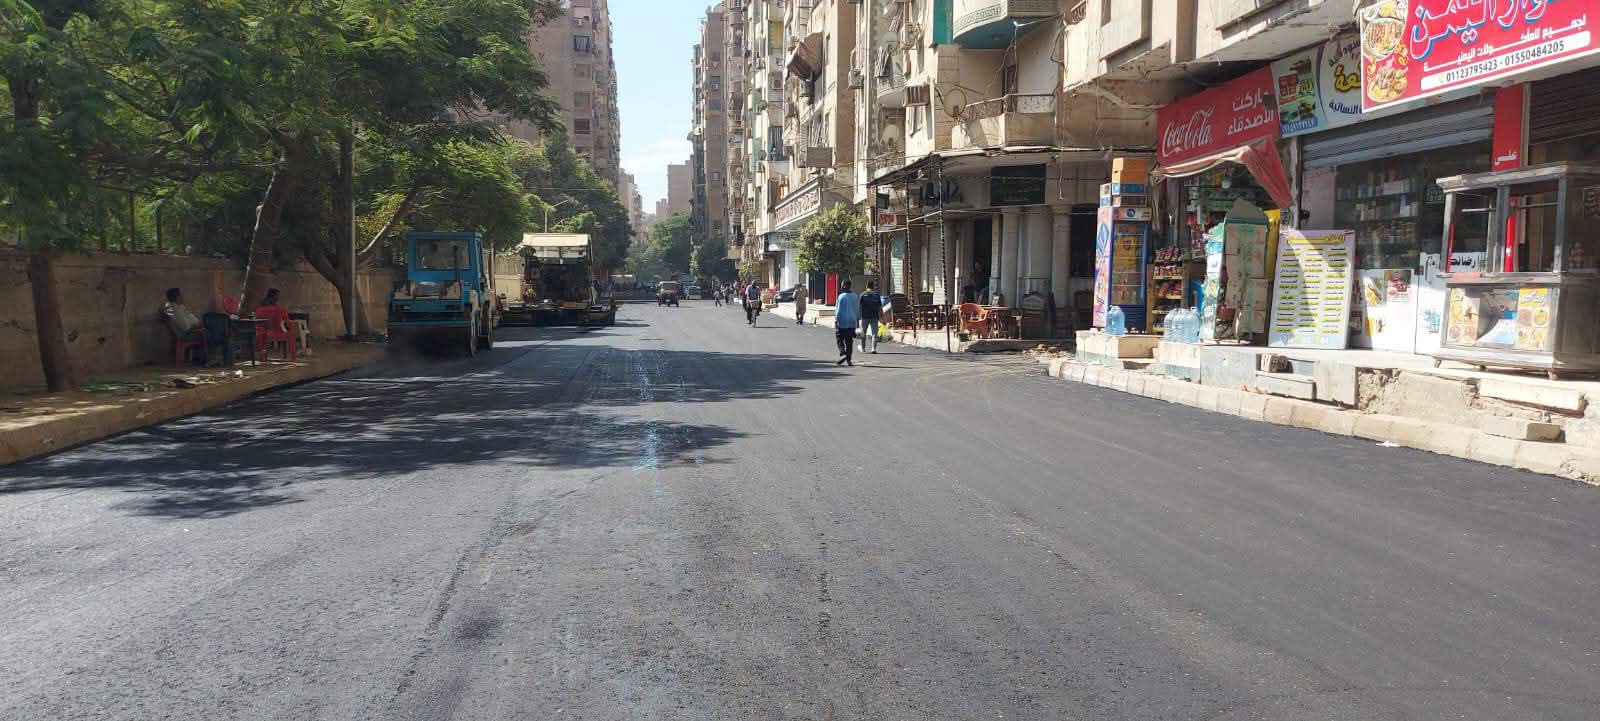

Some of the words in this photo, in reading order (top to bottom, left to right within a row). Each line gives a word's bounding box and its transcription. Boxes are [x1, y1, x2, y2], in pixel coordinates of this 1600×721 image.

[1446, 59, 1498, 82] 01123795423
[1504, 40, 1564, 66] 01550484205
[1161, 104, 1214, 157] Coca-Cola
